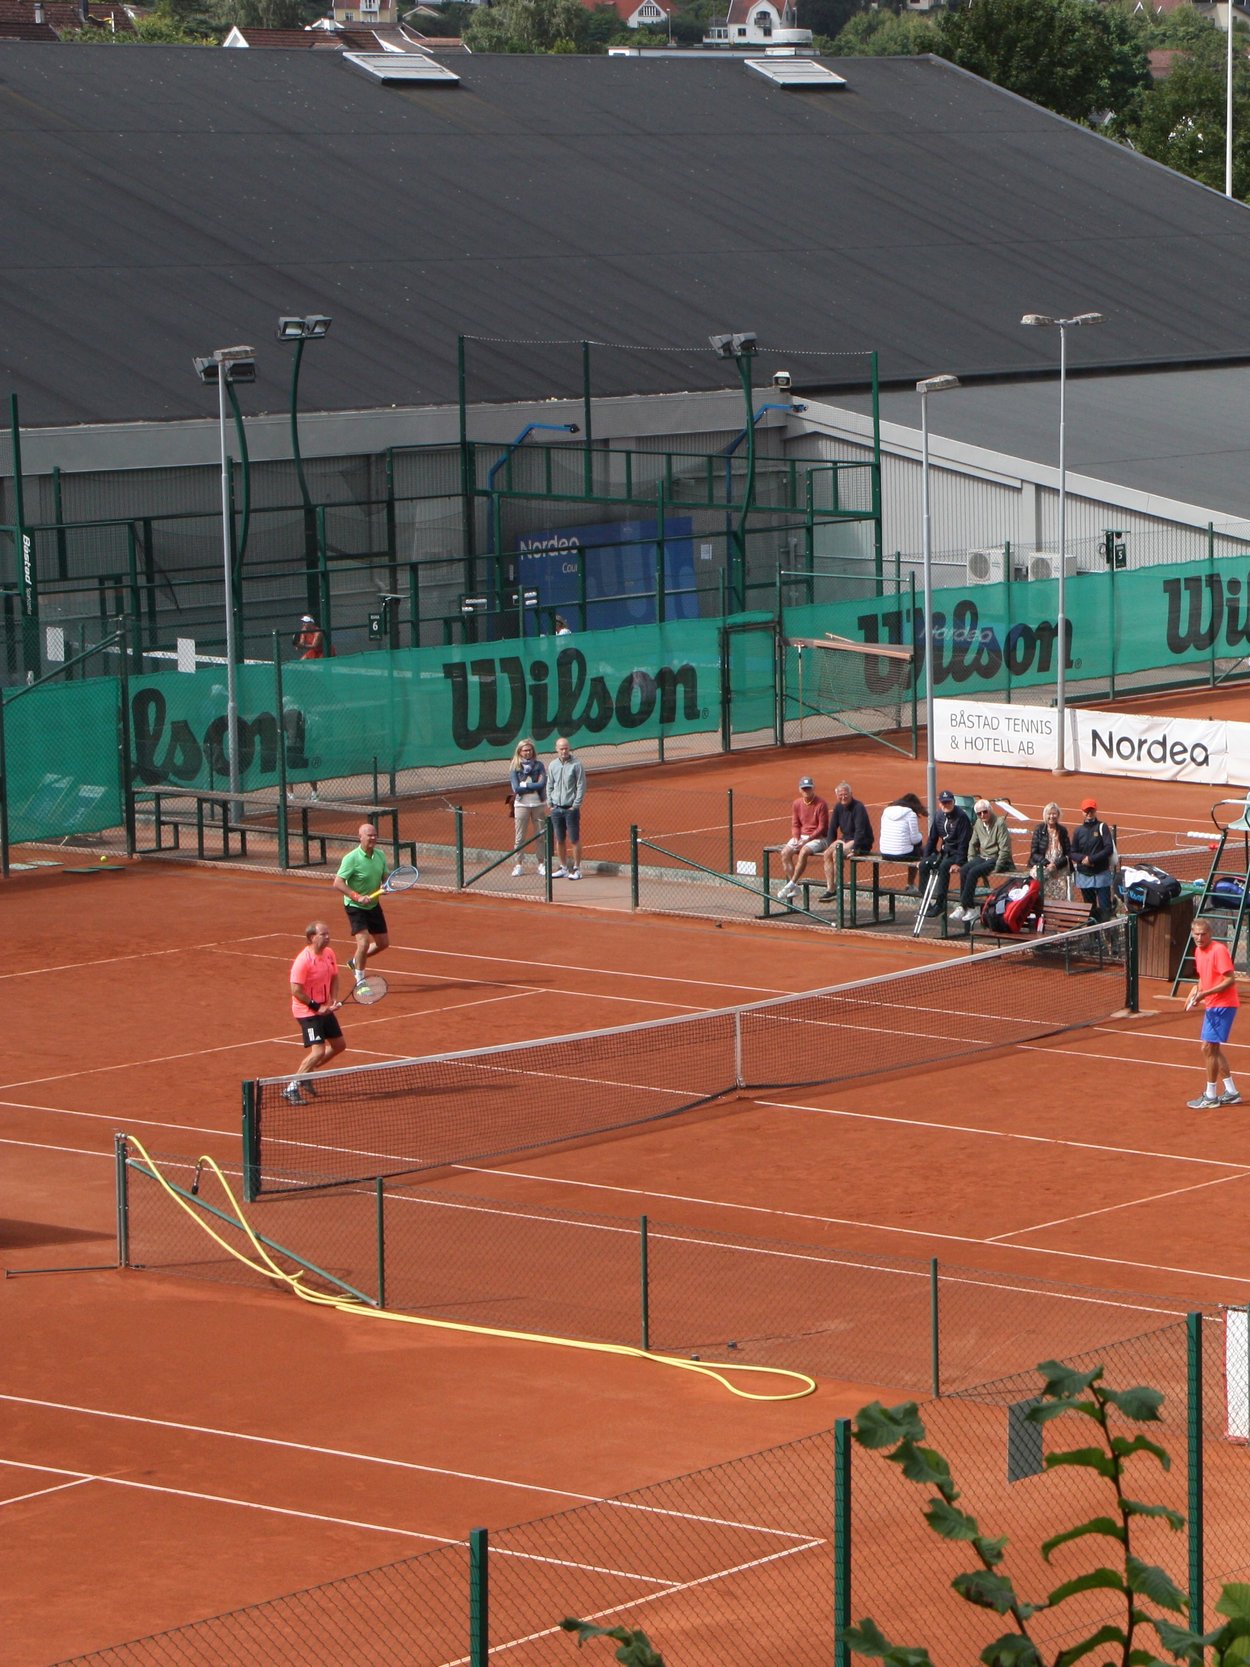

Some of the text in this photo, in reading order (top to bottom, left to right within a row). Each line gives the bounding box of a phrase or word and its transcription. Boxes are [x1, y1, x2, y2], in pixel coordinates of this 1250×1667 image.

[1118, 551, 1123, 560] 5
[372, 621, 379, 631] 6
[442, 647, 701, 750] Wilson
[950, 710, 1053, 735] BÅSTAD TENNIS
[950, 735, 1035, 756] & HOTELL AB
[1091, 728, 1210, 767] Nordea
